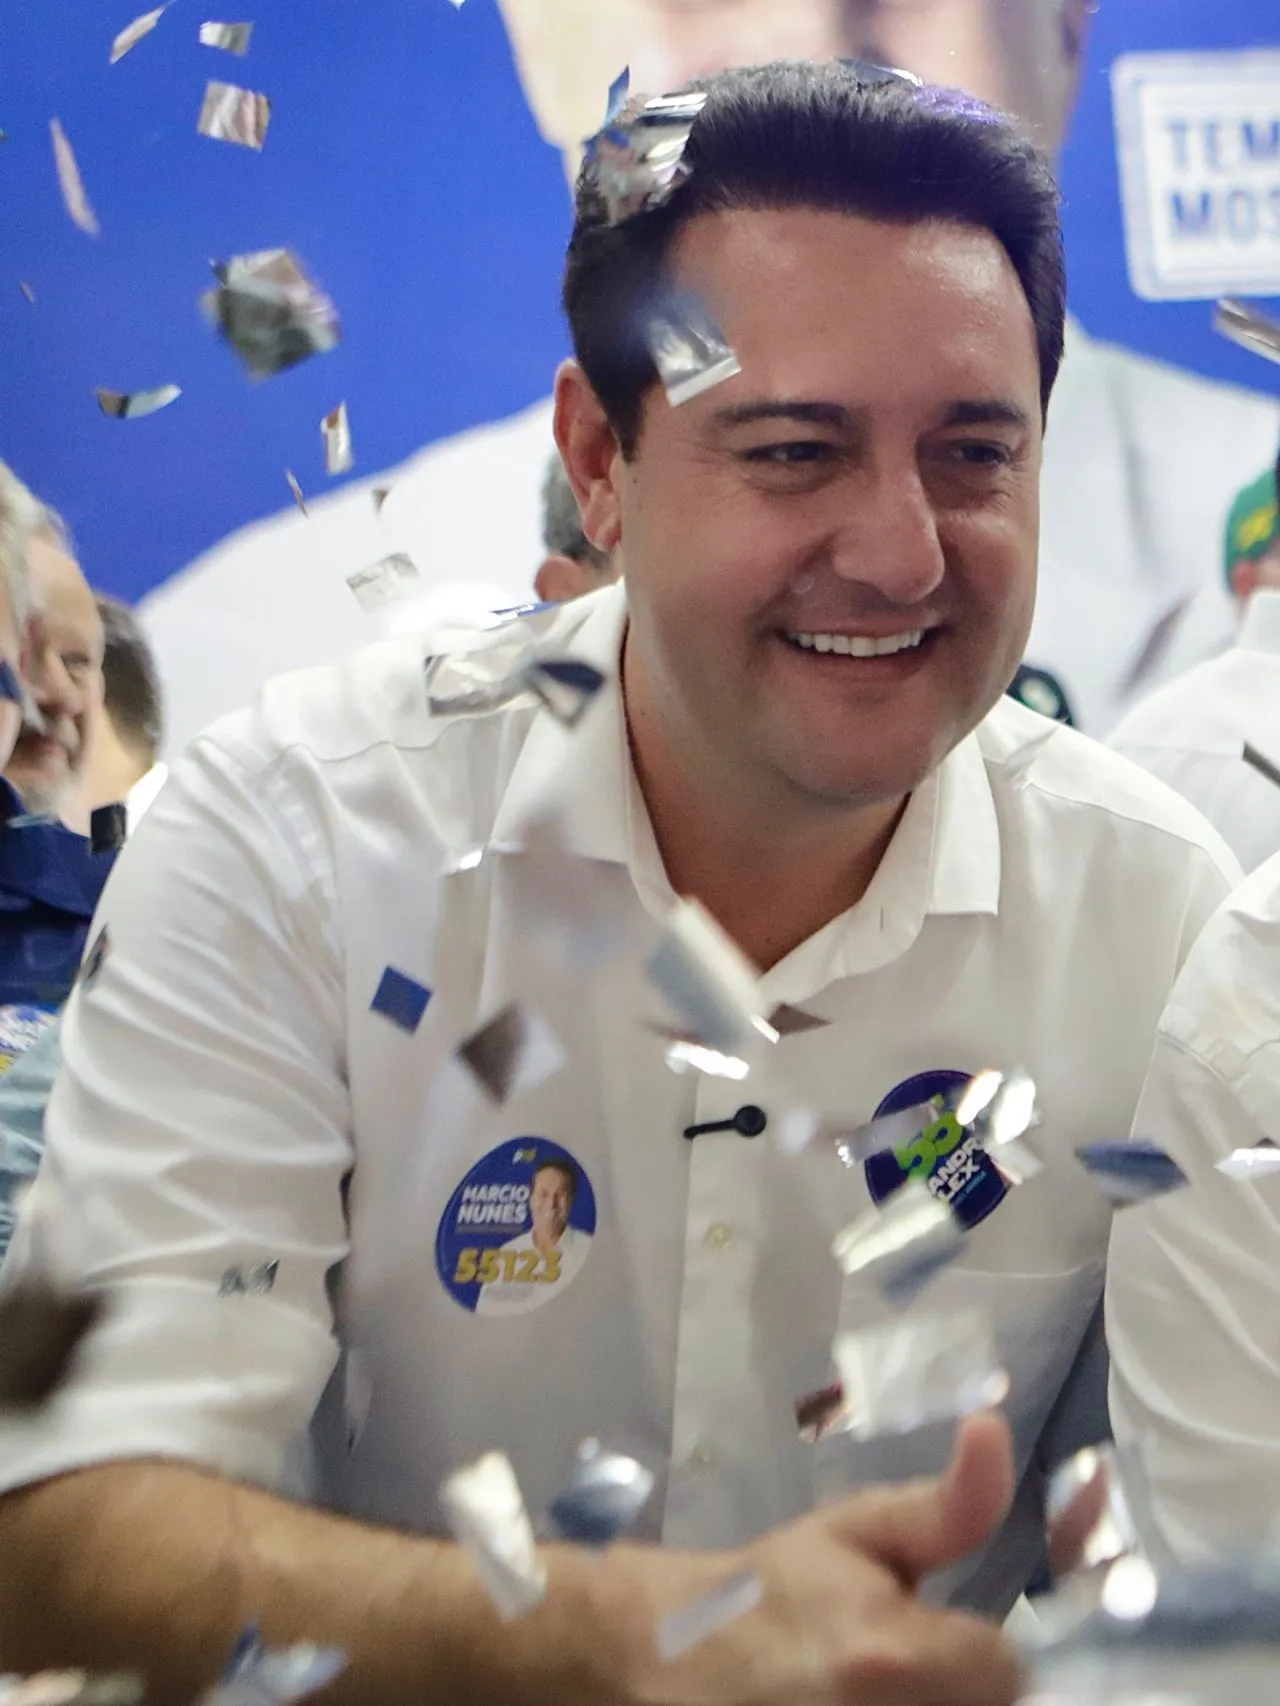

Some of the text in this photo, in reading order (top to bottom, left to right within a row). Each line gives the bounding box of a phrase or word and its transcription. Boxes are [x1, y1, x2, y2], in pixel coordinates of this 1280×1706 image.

[928, 1136, 985, 1196] ANDR
[462, 1184, 530, 1202] MARCIO
[457, 1203, 528, 1224] NUNES
[454, 1248, 563, 1285] 55123
